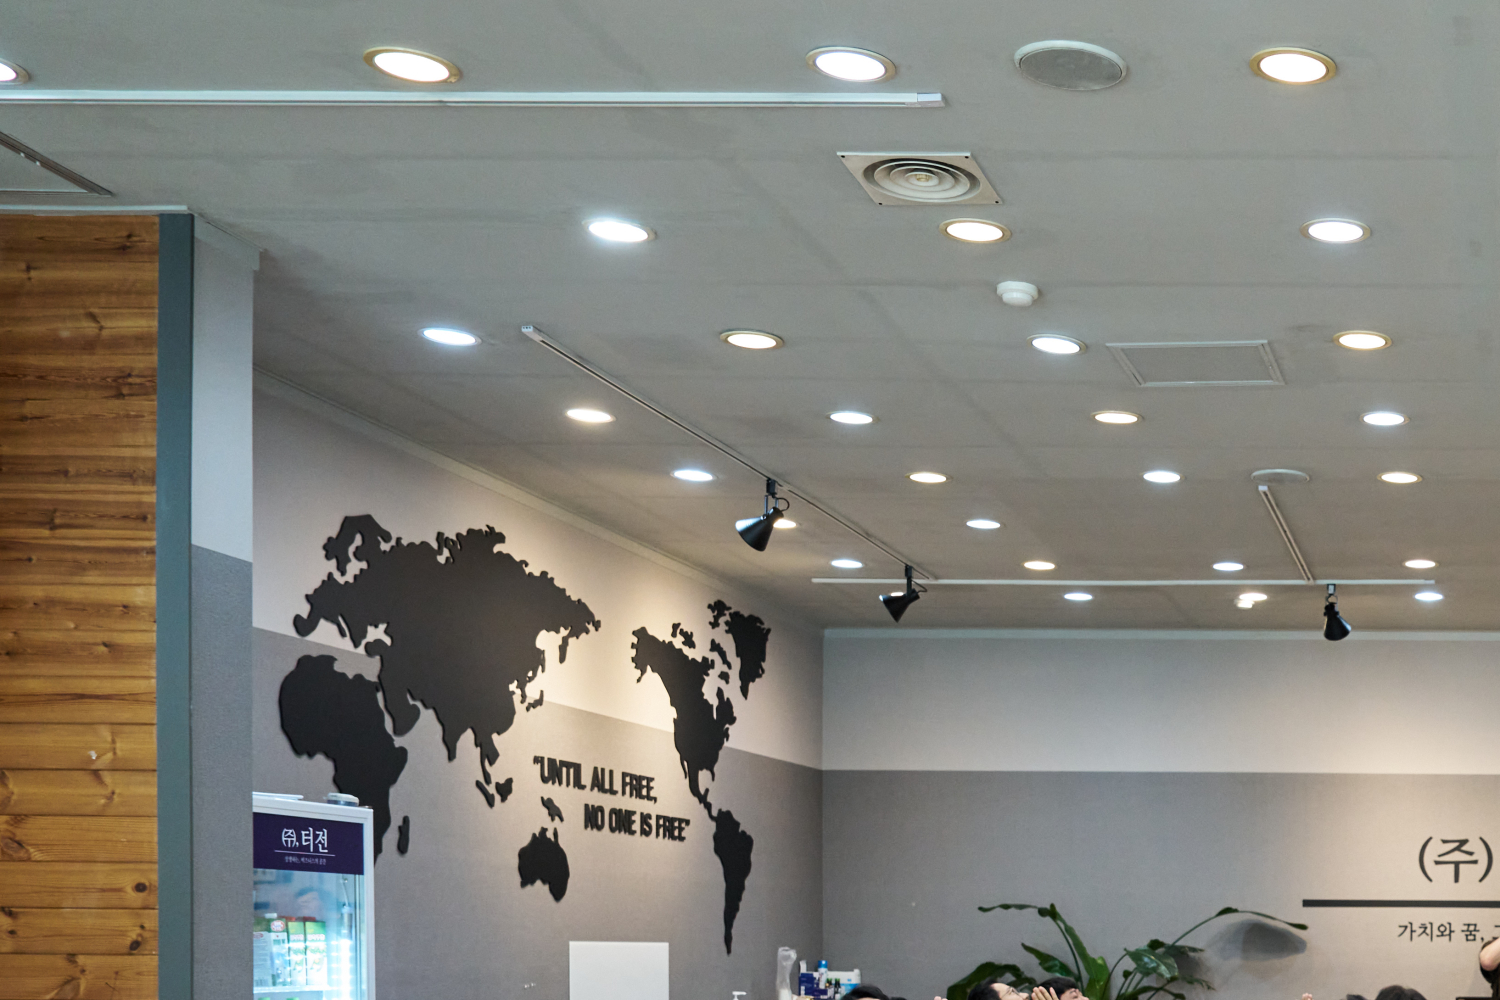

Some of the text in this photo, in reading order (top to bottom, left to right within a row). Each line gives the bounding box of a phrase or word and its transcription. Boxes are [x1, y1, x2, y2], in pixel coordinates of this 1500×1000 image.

[591, 767, 618, 795] ALL
[621, 772, 657, 804] FREE,
[584, 804, 605, 832] NO
[609, 808, 636, 836] ONE
[640, 812, 652, 837] IS
[1397, 921, 1455, 942] 가치와
[1461, 922, 1484, 943] 꿈,
